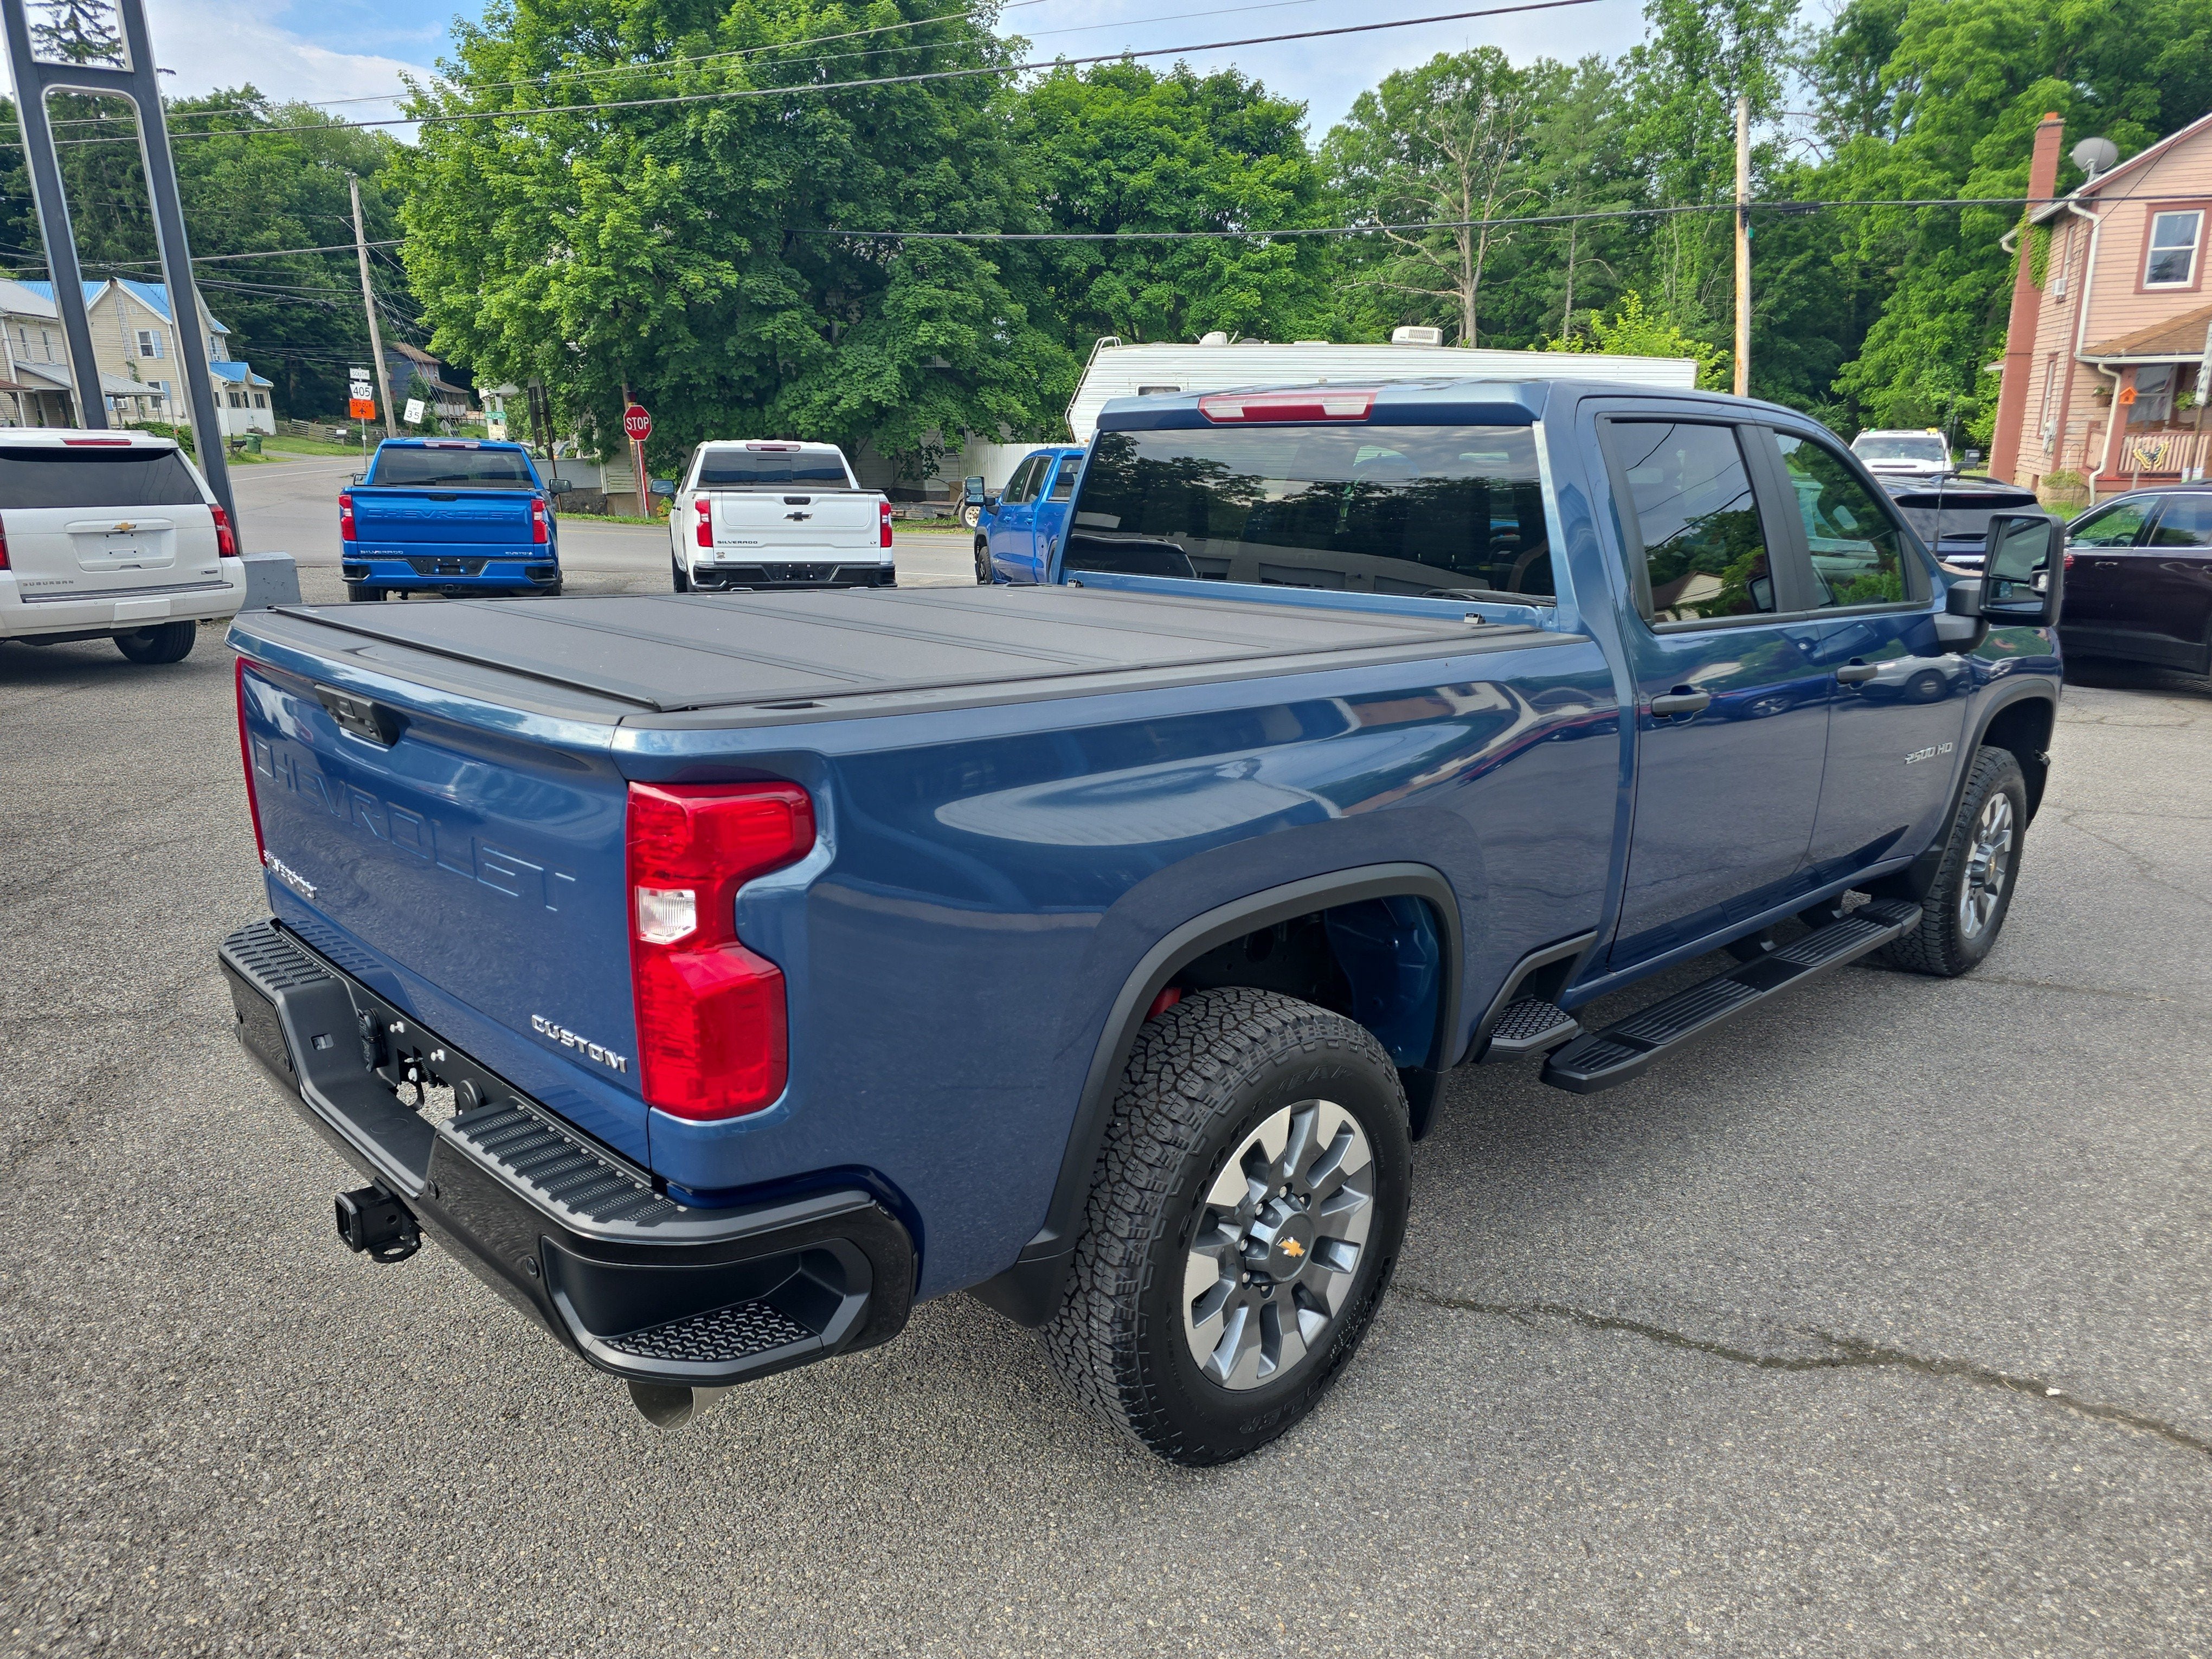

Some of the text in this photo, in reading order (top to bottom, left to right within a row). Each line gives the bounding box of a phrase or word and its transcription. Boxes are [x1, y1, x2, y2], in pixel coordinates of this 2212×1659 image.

[353, 387, 370, 396] 405
[407, 410, 420, 420] 35
[626, 416, 649, 430] STOP
[366, 508, 520, 520] CHEVROLET
[1905, 742, 1953, 764] 2500 HD
[253, 731, 577, 912] CHEVROLET
[531, 1014, 628, 1073] CUSTOM
[1178, 1064, 1353, 1249] GOODYEAR
[1239, 1256, 1392, 1434] WRANGLER
